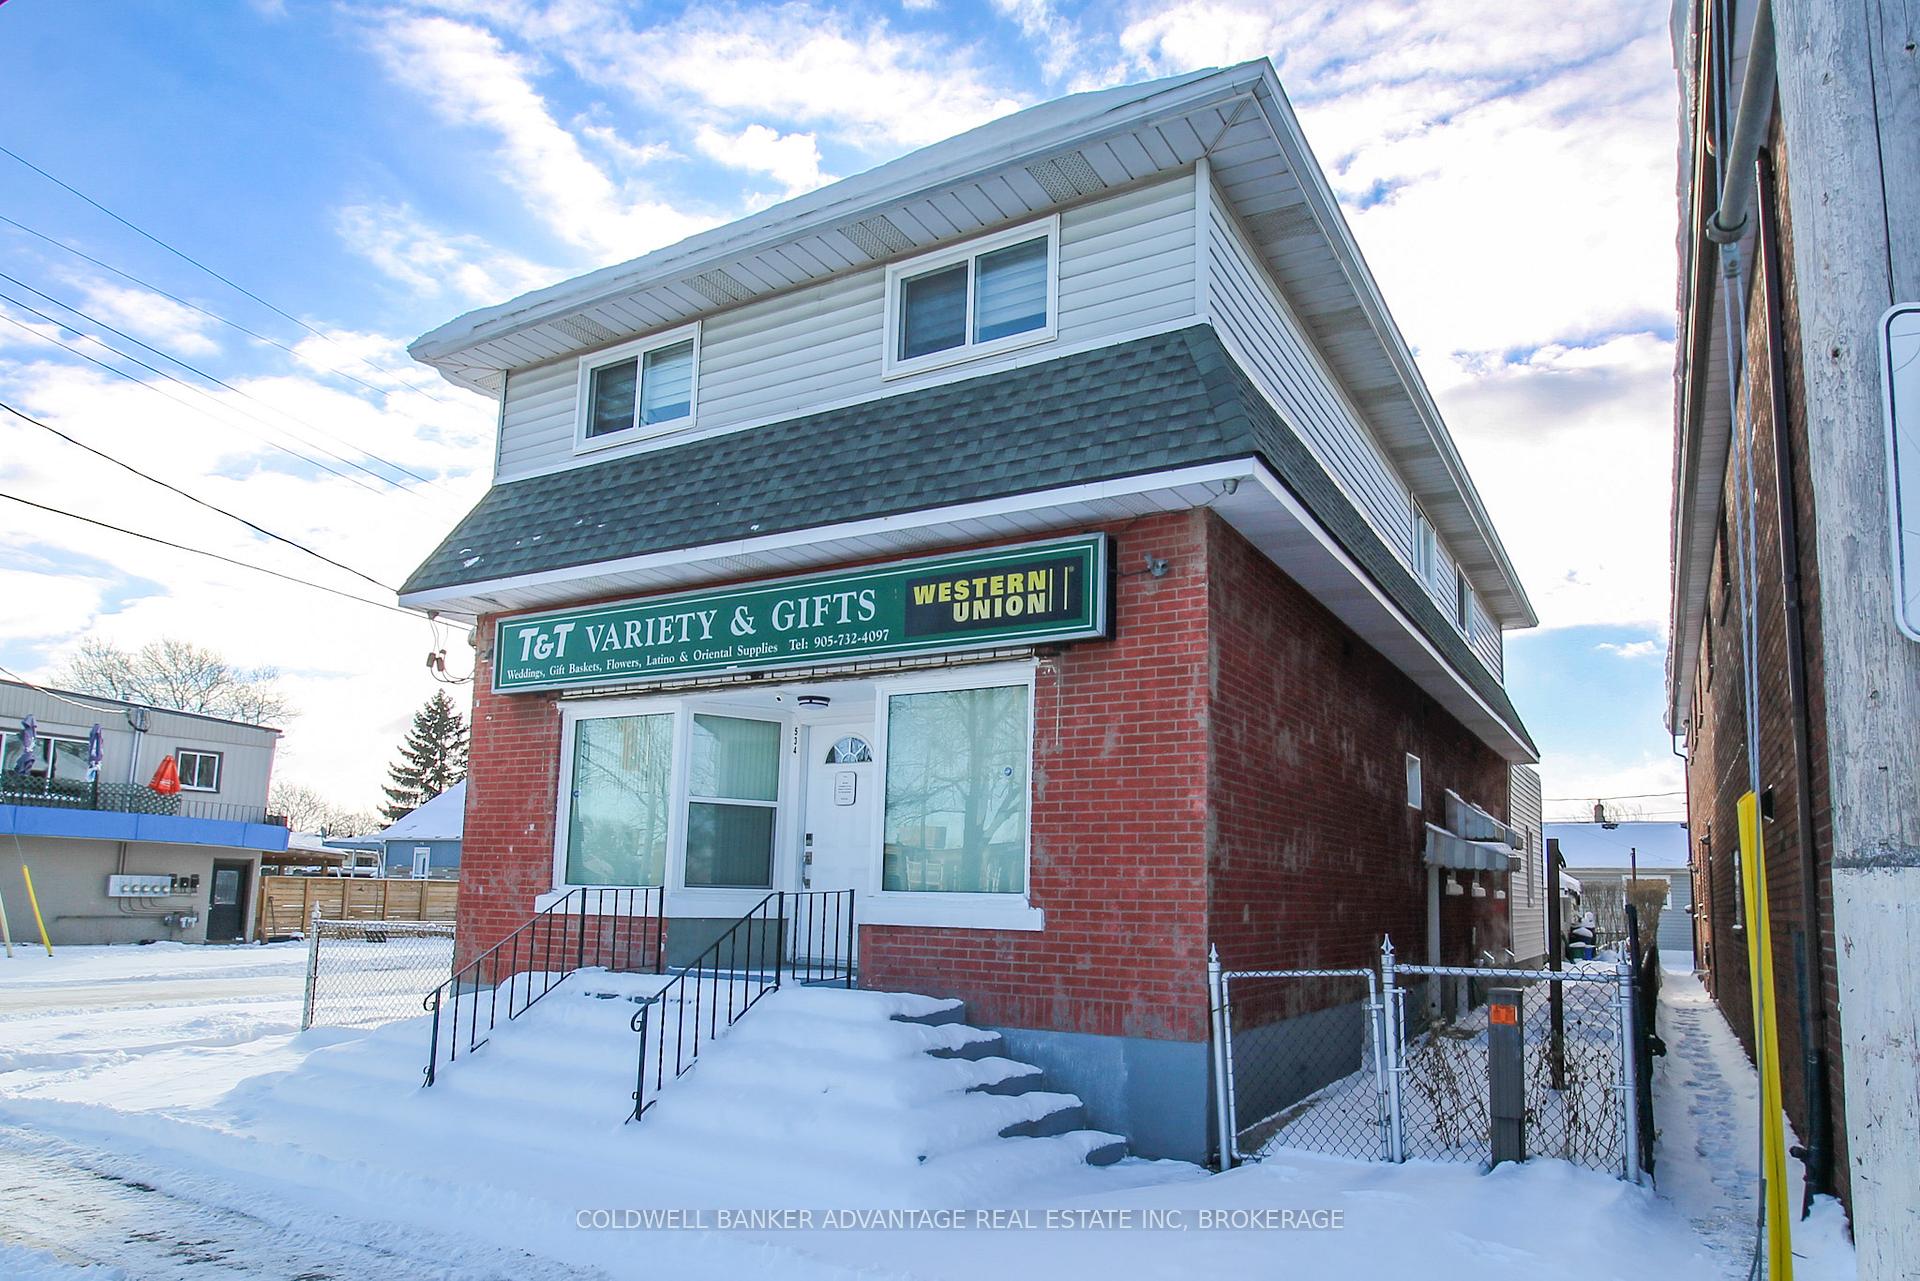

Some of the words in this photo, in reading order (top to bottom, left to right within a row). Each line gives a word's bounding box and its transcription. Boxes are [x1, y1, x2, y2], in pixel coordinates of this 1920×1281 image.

[913, 569, 1046, 606] WESTERN
[953, 592, 1046, 623] UNION
[518, 623, 575, 662] T&T
[586, 609, 717, 653] VARIETY
[730, 605, 758, 637] &
[771, 589, 876, 632] GIFTS
[507, 668, 546, 680] Weddings,
[550, 664, 565, 675] Gift
[569, 662, 602, 674] Baskets,
[607, 658, 642, 670] Flowers,
[647, 654, 675, 666] Latino
[679, 651, 689, 662] &
[693, 645, 733, 662] Oriental
[737, 642, 778, 659] Supplies
[789, 638, 808, 651] Tel:
[814, 629, 890, 649] 905-732-4097
